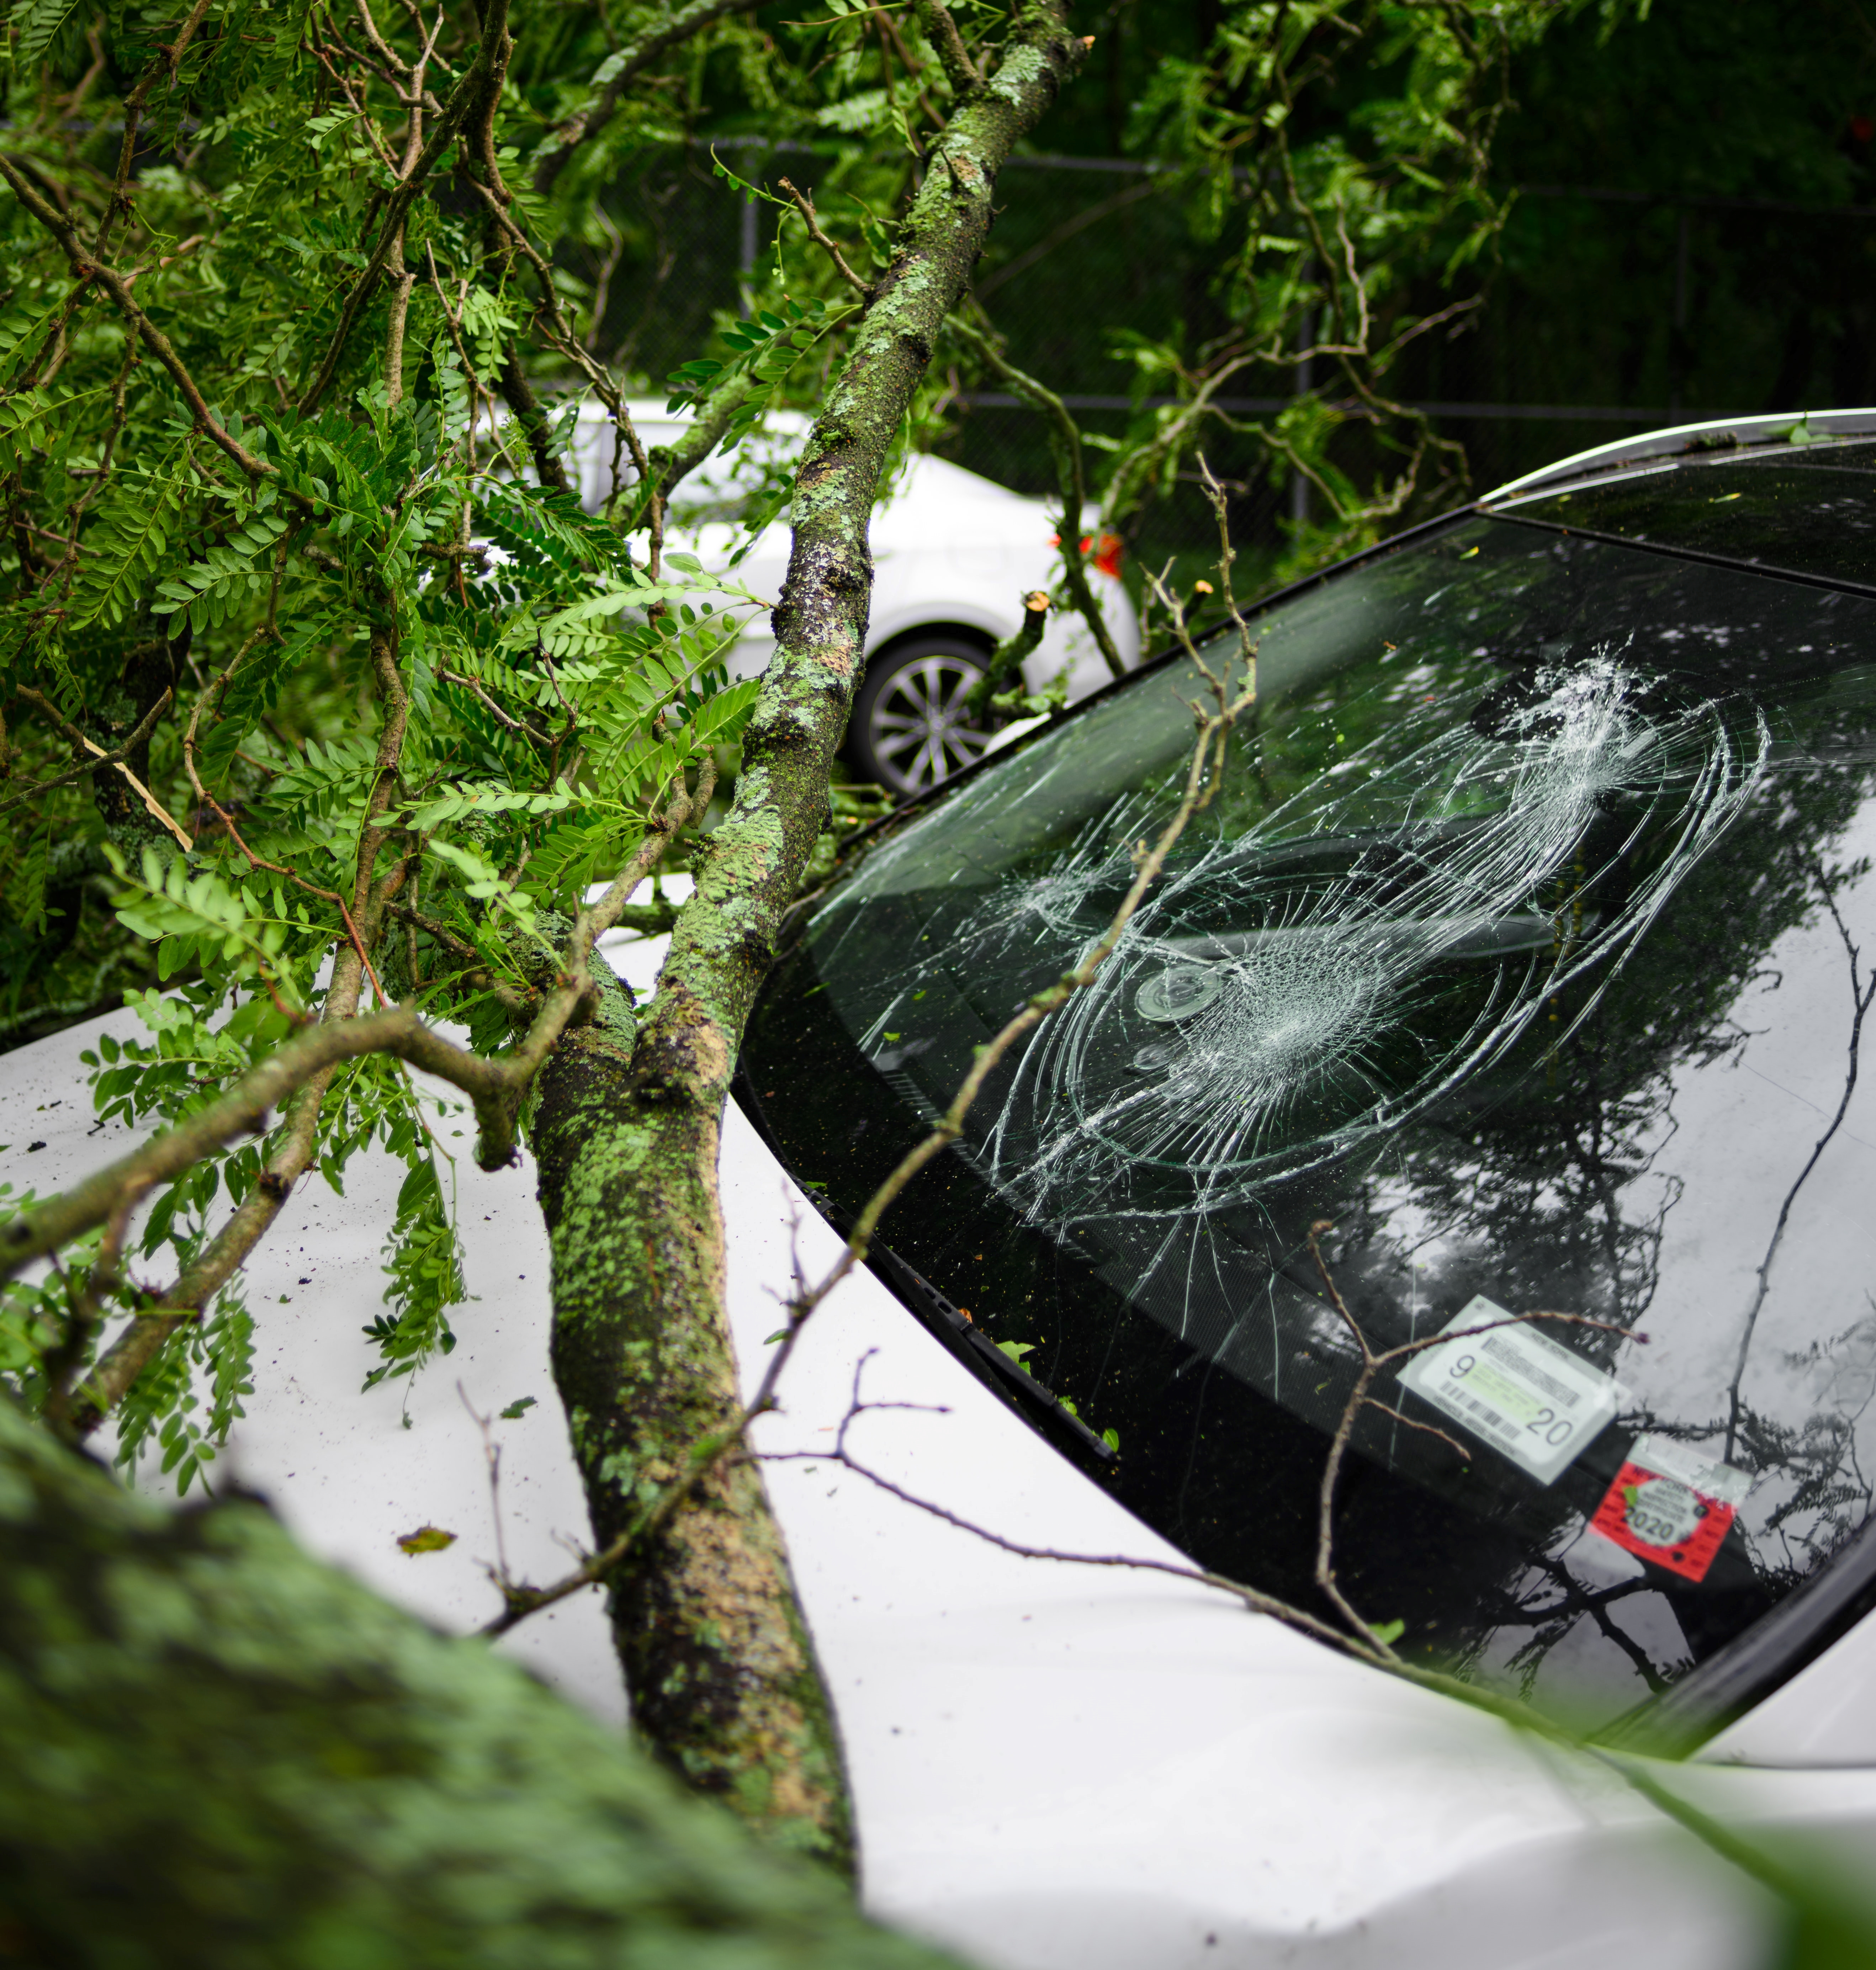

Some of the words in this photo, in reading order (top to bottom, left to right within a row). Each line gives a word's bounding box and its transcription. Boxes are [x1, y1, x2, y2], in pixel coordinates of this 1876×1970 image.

[1530, 1332, 1550, 1347] NEW
[1548, 1344, 1572, 1360] YORK
[1450, 1355, 1475, 1378] 9
[1526, 1407, 1573, 1446] 20
[1432, 1395, 1464, 1419] VEHICLE
[1464, 1417, 1517, 1456] REGISTRATION
[1621, 1507, 1674, 1540] 2020
